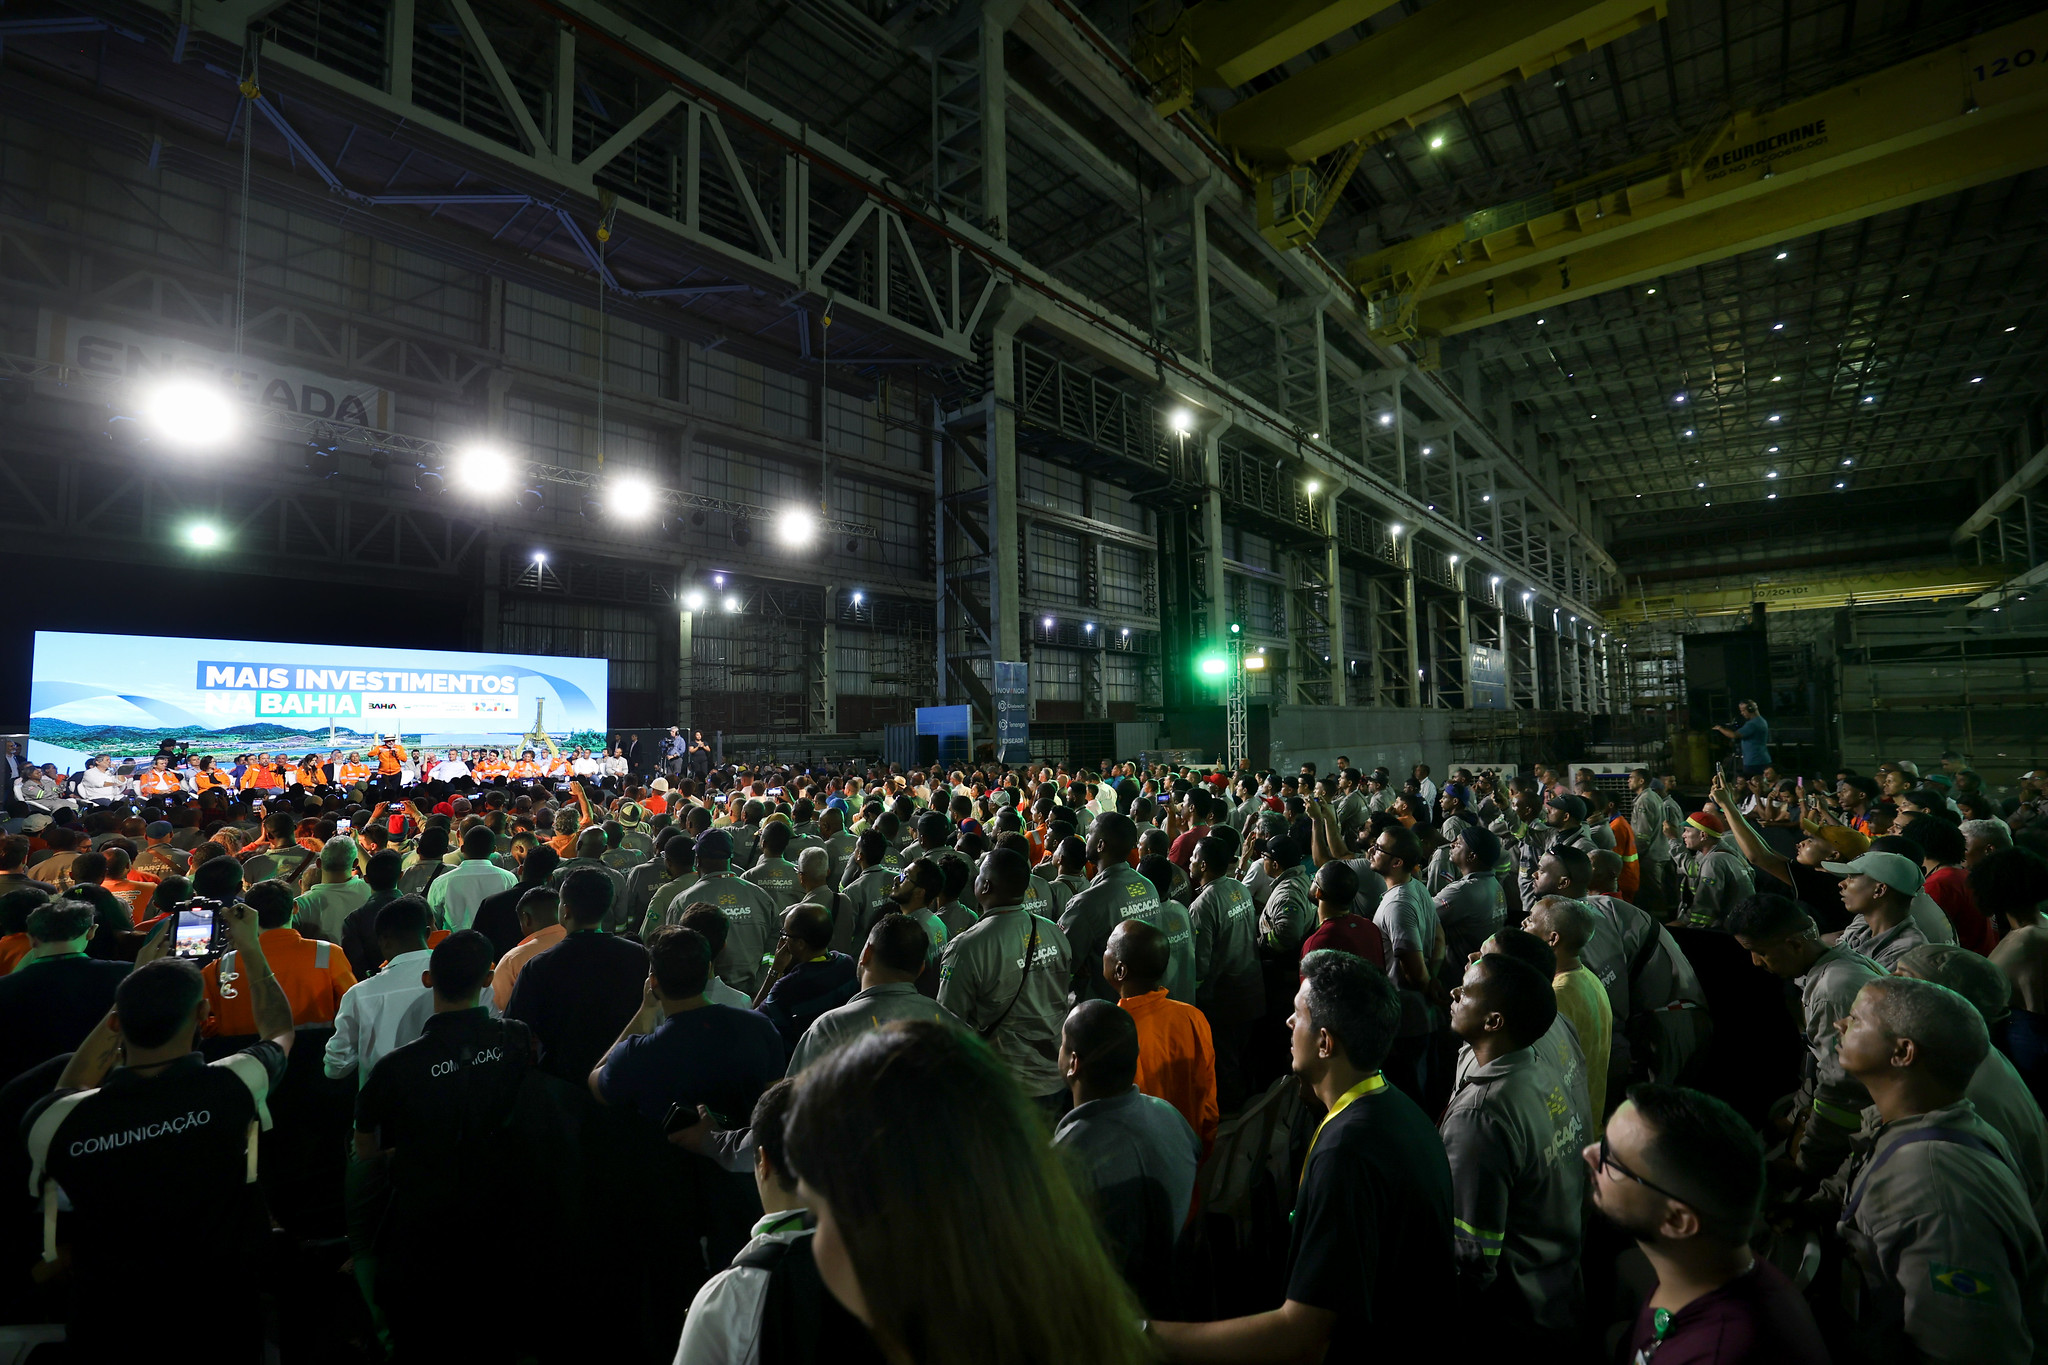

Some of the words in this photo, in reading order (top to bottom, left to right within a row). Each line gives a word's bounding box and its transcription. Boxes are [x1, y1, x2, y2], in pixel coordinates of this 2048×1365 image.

[1722, 119, 1826, 166] EUROCRANE
[1705, 169, 1727, 182] TAG
[76, 334, 369, 427] ENEADA
[205, 665, 290, 690] MAIS
[295, 668, 516, 694] INVESTIMENTOS
[204, 692, 255, 714] NA
[259, 692, 357, 715] BAHIA
[368, 702, 397, 710] BAHIA
[757, 879, 793, 890] BARCAÇAS
[1016, 945, 1058, 969] BCAÇAS
[69, 1109, 211, 1158] COMUNICAÇÃO
